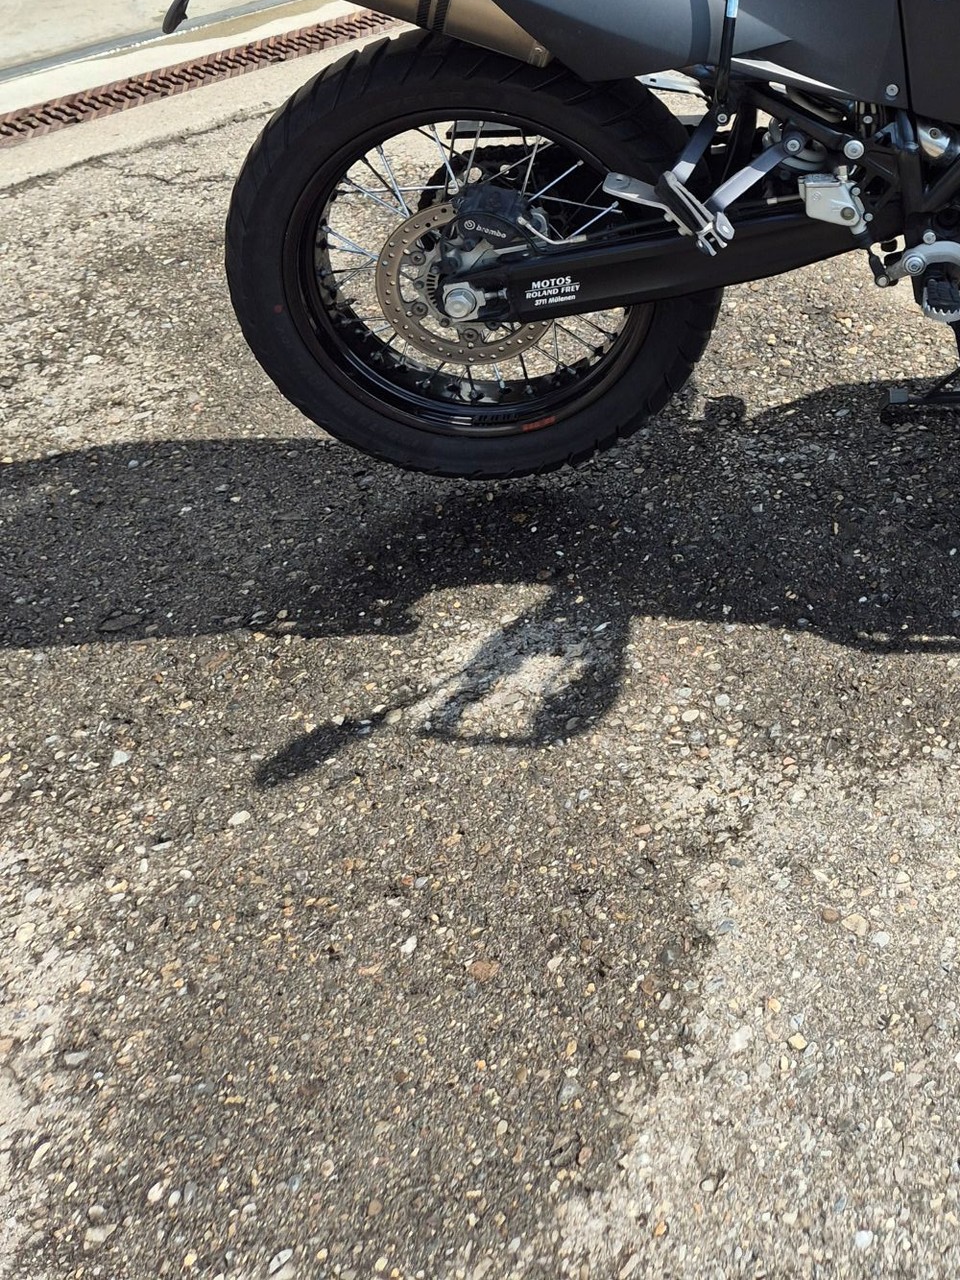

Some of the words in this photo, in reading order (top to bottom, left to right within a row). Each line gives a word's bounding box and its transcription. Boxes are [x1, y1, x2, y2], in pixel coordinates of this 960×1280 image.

[476, 224, 507, 239] brembo
[531, 275, 572, 289] MOTOS
[525, 288, 559, 300] ROLAND
[560, 284, 581, 294] FREY
